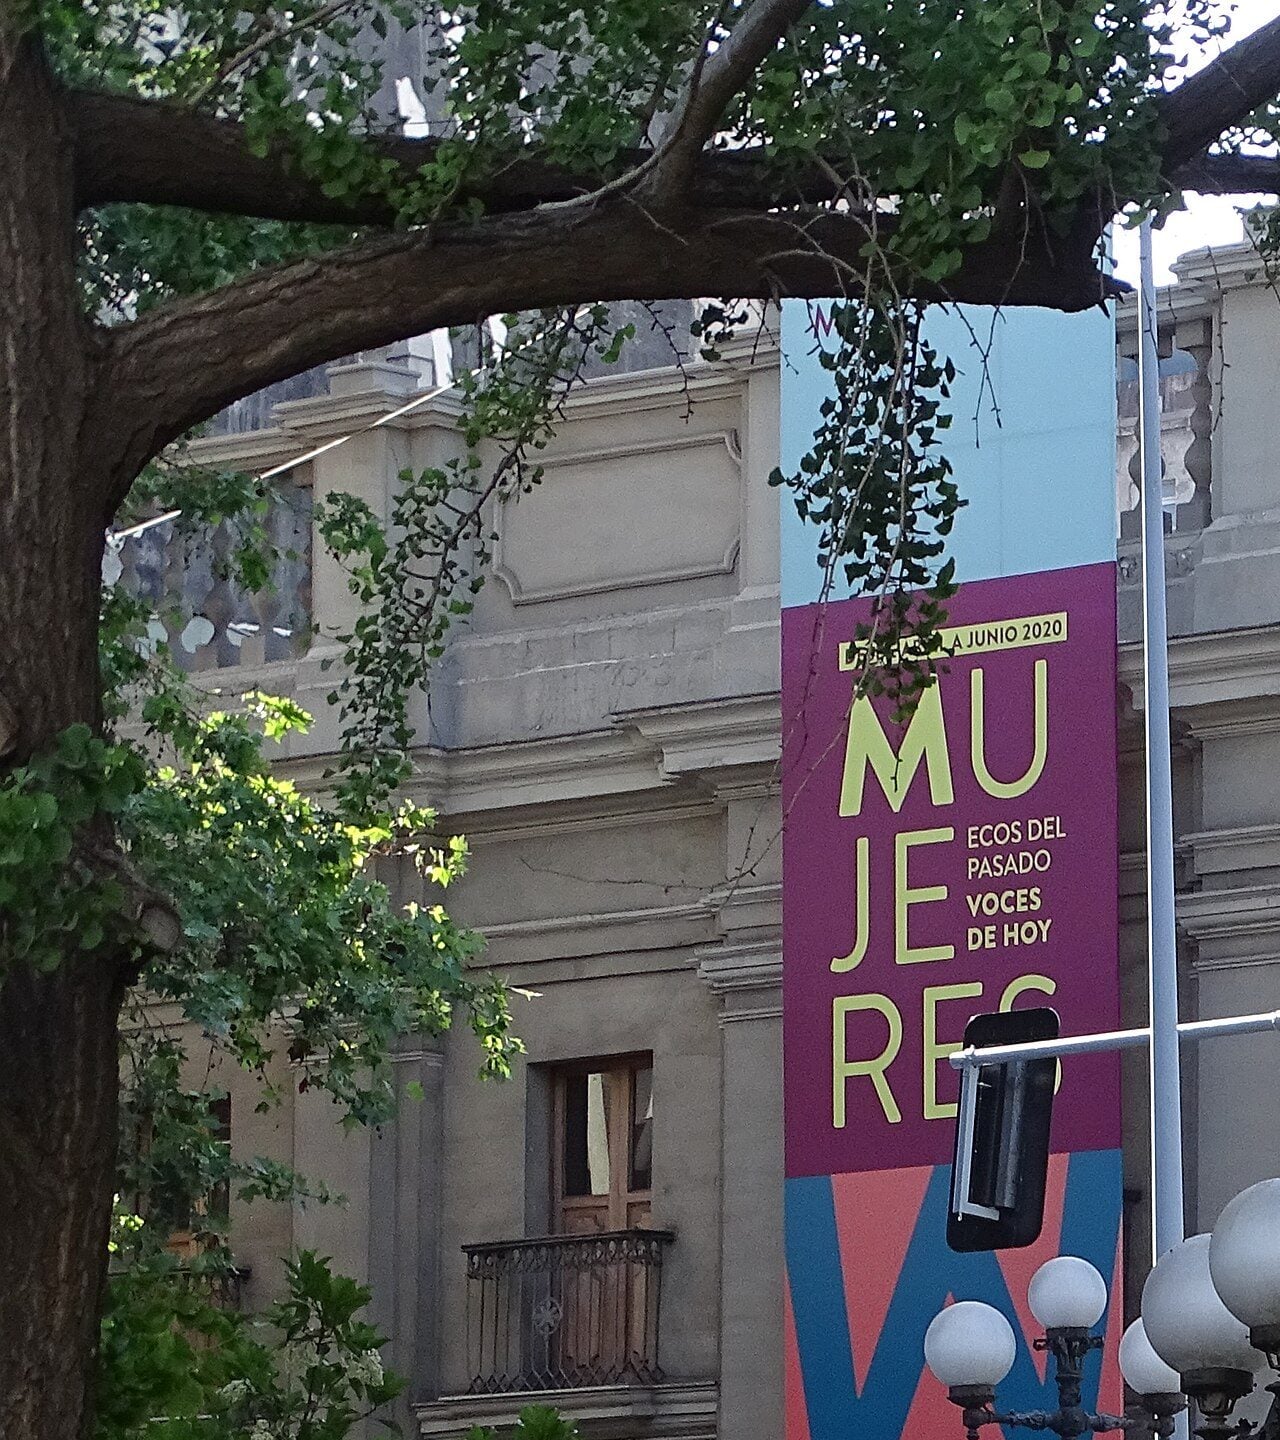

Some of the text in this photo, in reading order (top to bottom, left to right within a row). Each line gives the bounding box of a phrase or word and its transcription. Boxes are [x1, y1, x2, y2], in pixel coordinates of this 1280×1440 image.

[966, 626, 1017, 648] JUNIO
[1022, 619, 1062, 641] 2020
[838, 658, 1049, 817] MU
[967, 816, 1067, 849] ECOS DEL
[967, 849, 1051, 880] PASADO
[830, 826, 954, 973] JE
[966, 886, 1042, 917] VOCES
[967, 918, 1052, 951] DE HOY
